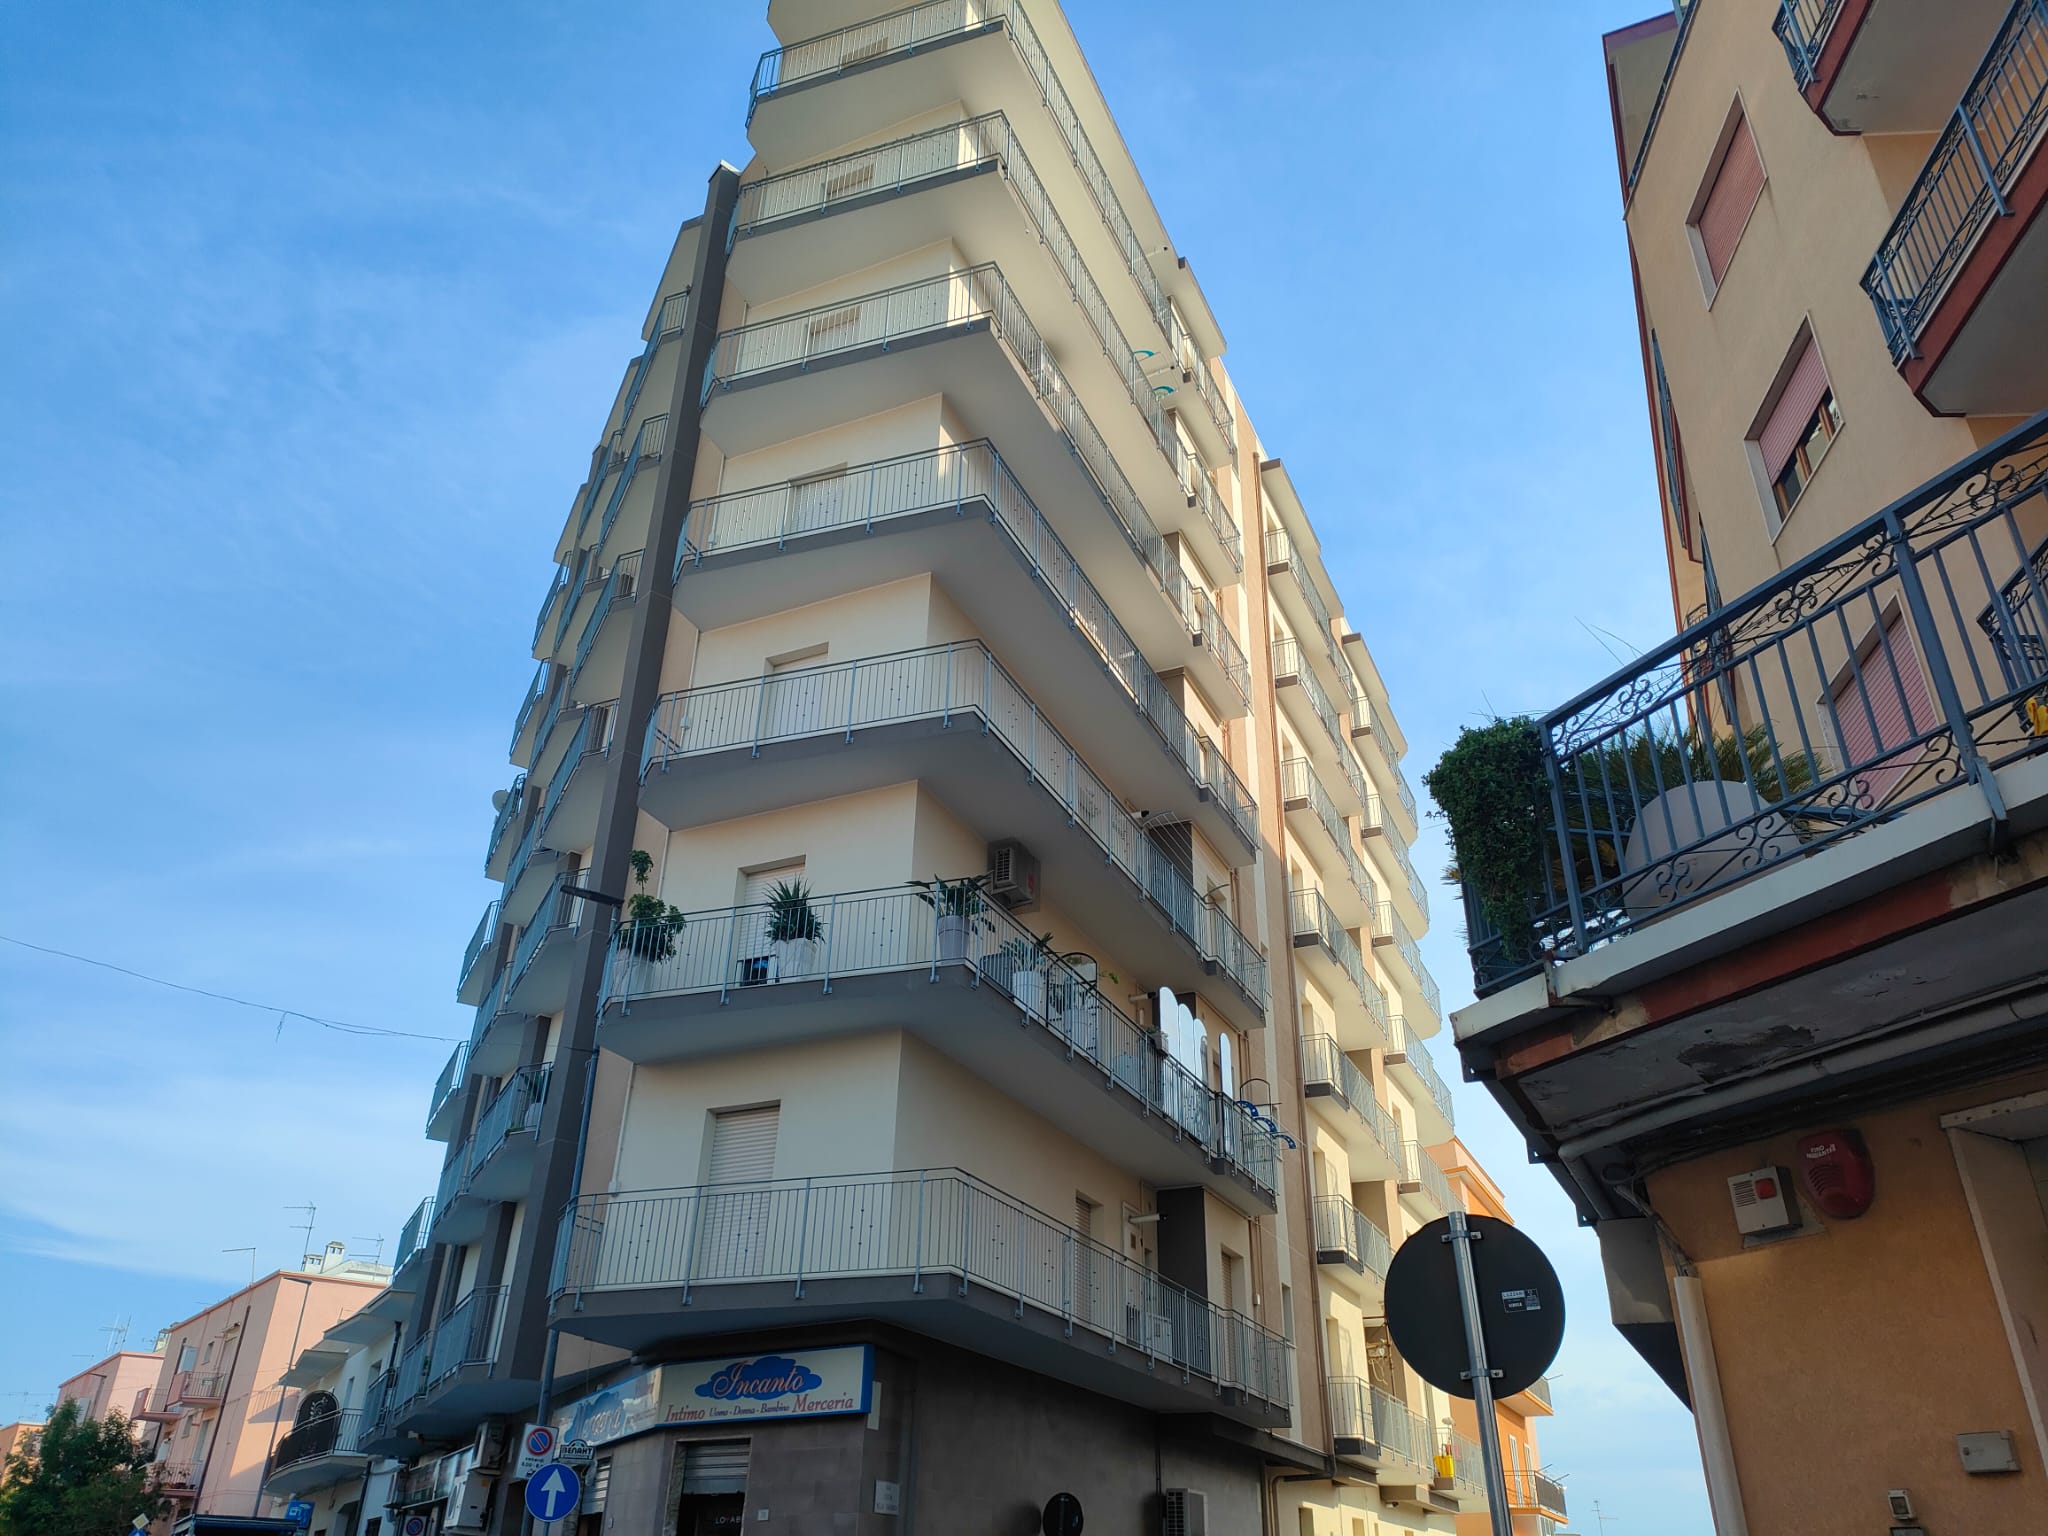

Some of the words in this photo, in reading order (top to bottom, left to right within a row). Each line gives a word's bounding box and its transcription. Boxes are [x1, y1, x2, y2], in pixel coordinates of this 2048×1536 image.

[712, 1360, 805, 1398] Incanto
[664, 1404, 705, 1422] Intimo
[792, 1391, 853, 1412] Merceria
